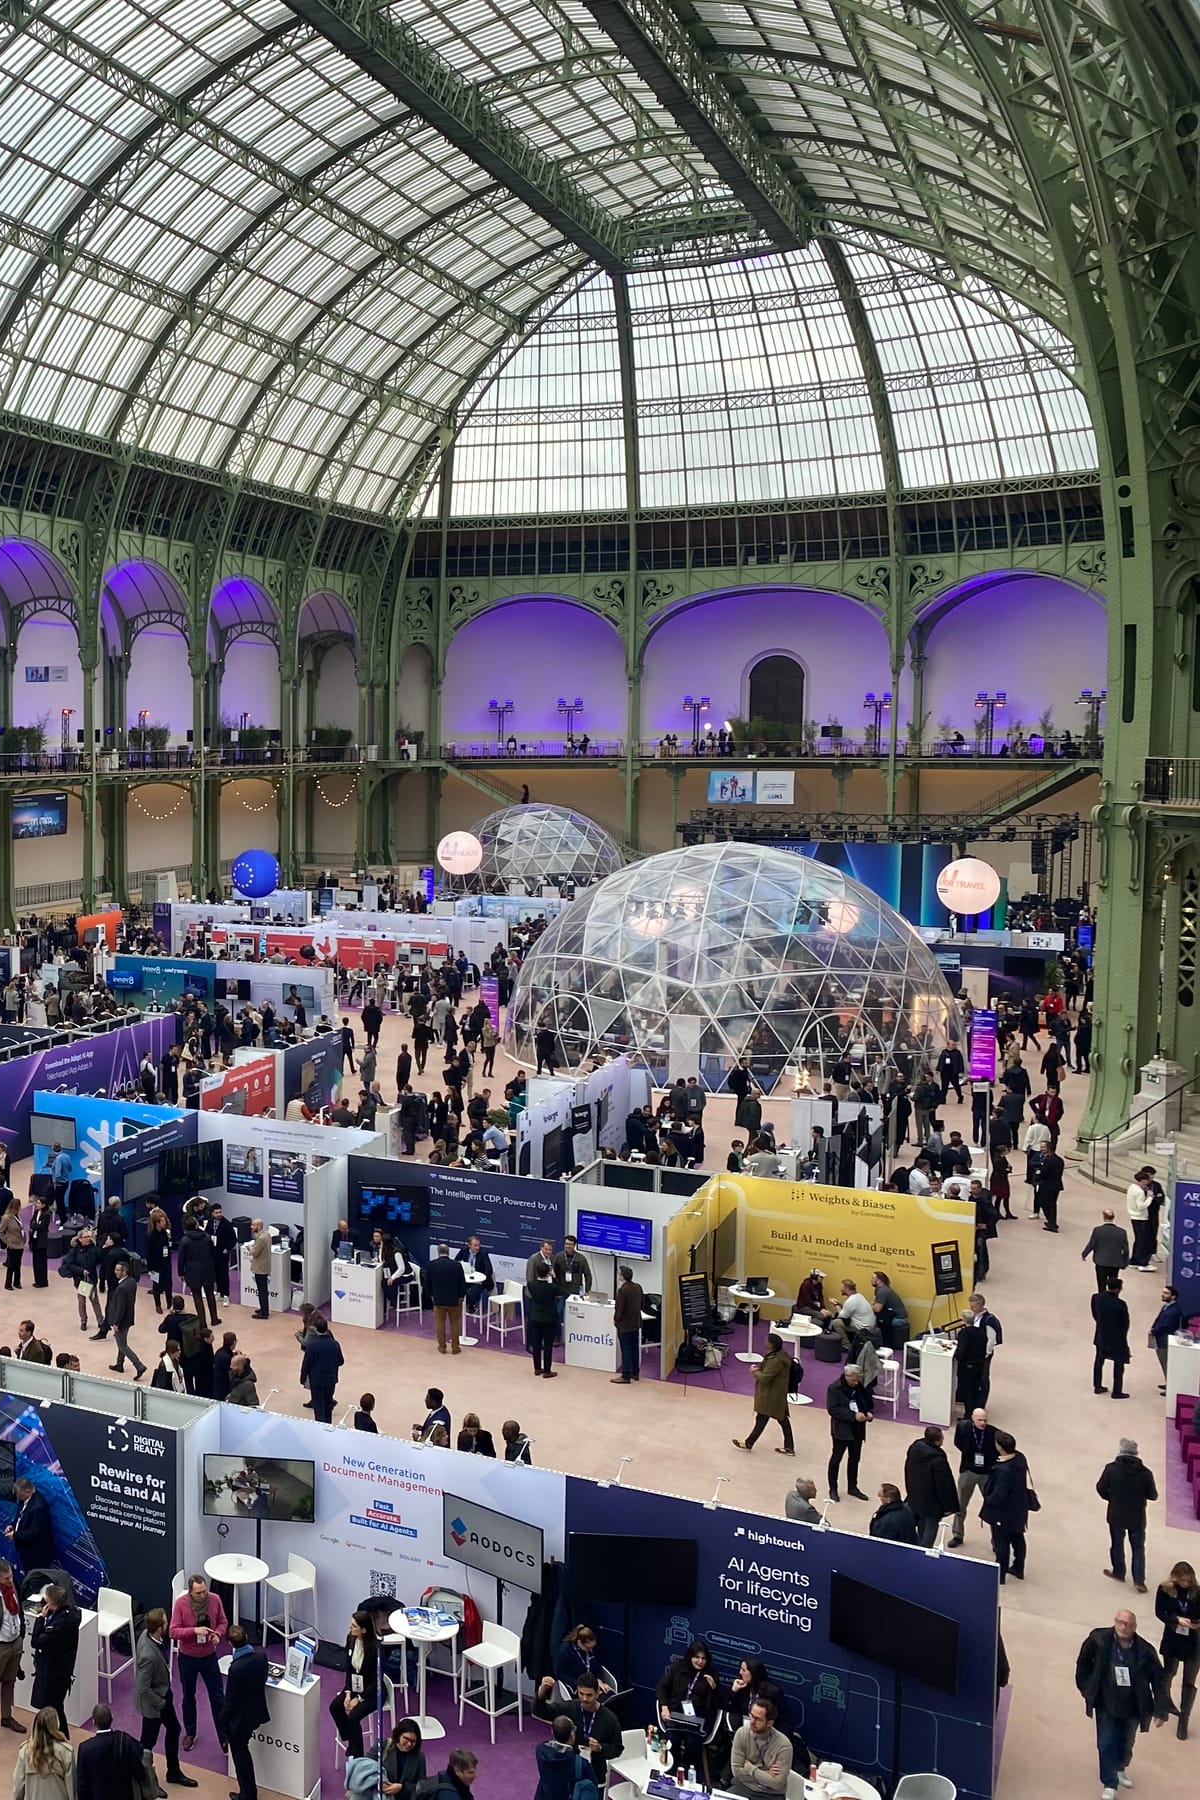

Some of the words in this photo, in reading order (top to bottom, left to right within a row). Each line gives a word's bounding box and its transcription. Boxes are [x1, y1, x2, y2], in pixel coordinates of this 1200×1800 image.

[438, 1174, 464, 1183] TREASURE
[429, 1186, 444, 1196] The
[445, 1188, 482, 1201] Intelligent
[503, 1196, 536, 1209] Powered
[537, 1202, 548, 1211] by
[549, 1203, 558, 1211] AI
[809, 1192, 850, 1206] Weights
[852, 1197, 860, 1206] &
[862, 1199, 896, 1211] Biases
[771, 1230, 798, 1242] Build
[801, 1234, 812, 1243] AI
[815, 1236, 854, 1250] models
[856, 1242, 877, 1252] and
[879, 1245, 916, 1257] agents
[133, 1434, 165, 1449] DIGITAL
[133, 1443, 165, 1457] REALTY
[99, 1463, 144, 1484] Rewire
[146, 1474, 166, 1489] for
[323, 1462, 375, 1482] Document
[342, 1455, 365, 1469] New
[368, 1461, 426, 1481] Generation
[91, 1475, 121, 1494] Data
[123, 1485, 148, 1500] and
[151, 1490, 165, 1504] AI
[90, 1503, 108, 1513] global
[109, 1506, 122, 1516] data
[95, 1495, 120, 1507] Discover
[120, 1500, 134, 1510] how
[134, 1504, 144, 1513] the
[145, 1506, 166, 1518] largest
[367, 1510, 400, 1523] Accurate.
[375, 1501, 392, 1511] Fast.
[86, 1510, 98, 1519] can
[99, 1512, 119, 1524] enable
[120, 1518, 134, 1528] your
[134, 1521, 142, 1529] AI
[142, 1523, 166, 1537] journey
[351, 1516, 368, 1526] Built
[369, 1519, 380, 1528] for
[380, 1522, 388, 1530] AI
[389, 1524, 416, 1537] Agents.
[470, 1532, 535, 1567] AODOCS
[748, 1530, 805, 1551] hightouch
[728, 1557, 744, 1572] AI
[748, 1561, 810, 1587] Agents
[718, 1574, 743, 1591] for
[747, 1579, 819, 1610] lifecycle
[724, 1598, 812, 1632] marketing
